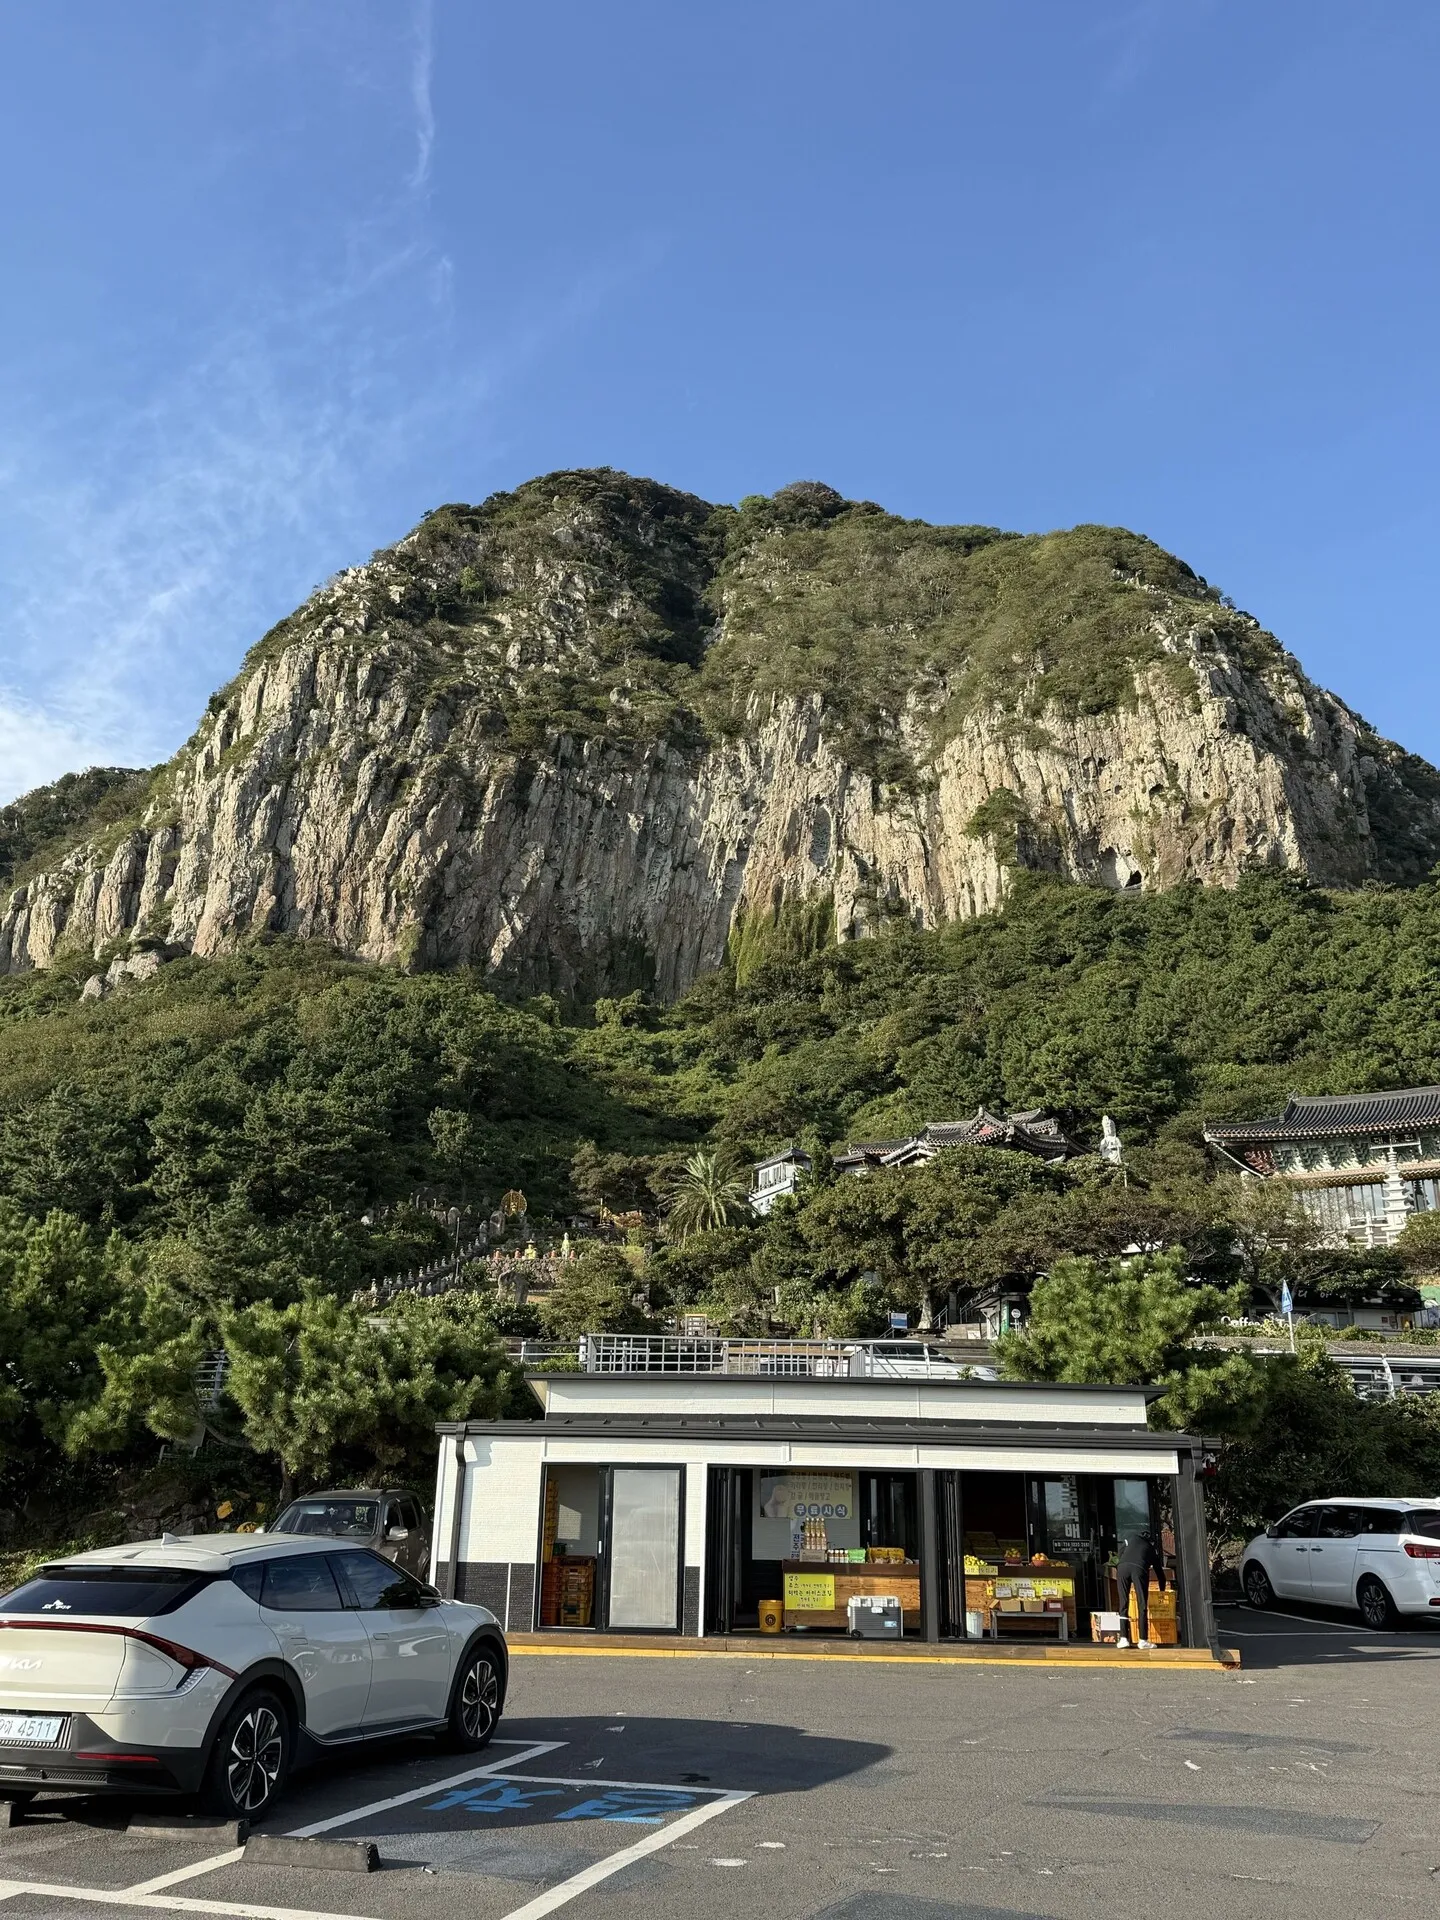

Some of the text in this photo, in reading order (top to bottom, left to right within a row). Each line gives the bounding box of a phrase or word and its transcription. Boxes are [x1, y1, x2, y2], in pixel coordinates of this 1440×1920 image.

[796, 1504, 846, 1517] 무료시식
[1061, 1475, 1080, 1538] 전국택배
[18, 1720, 51, 1738] 4511
